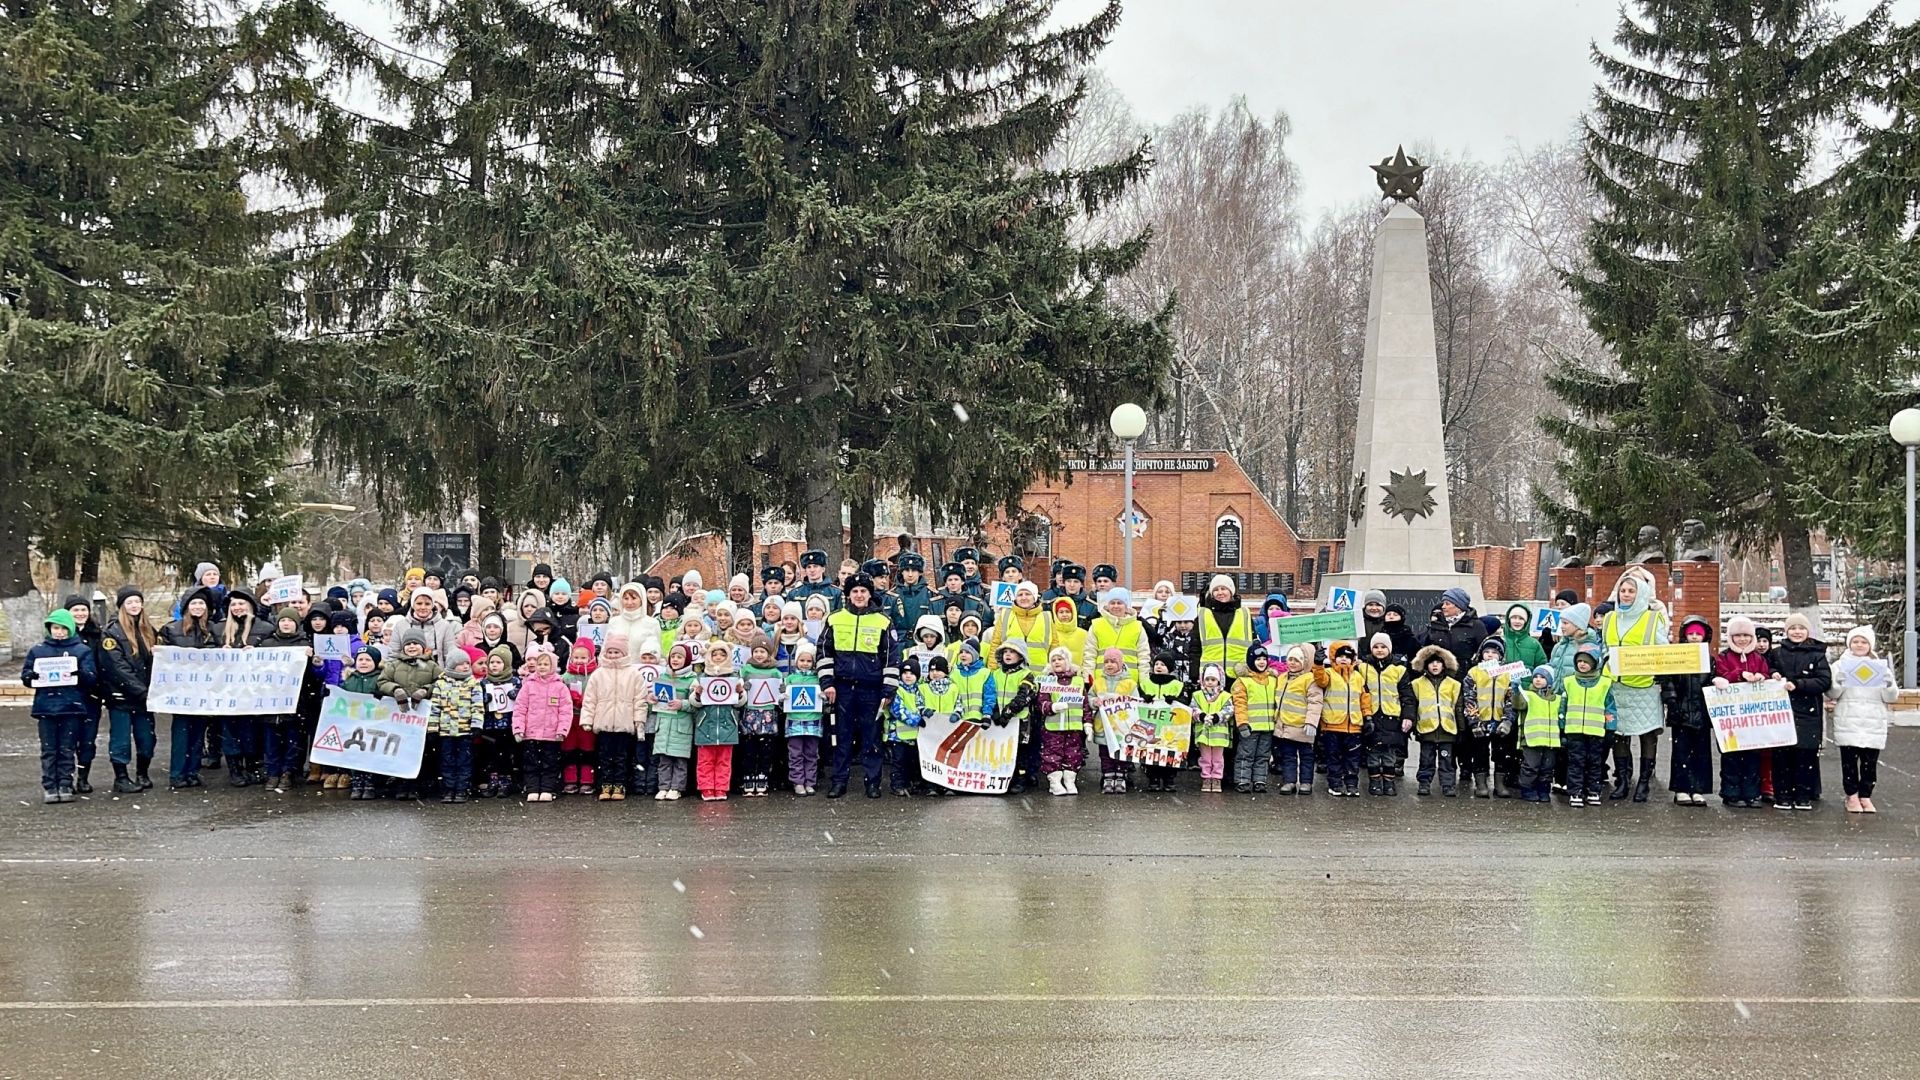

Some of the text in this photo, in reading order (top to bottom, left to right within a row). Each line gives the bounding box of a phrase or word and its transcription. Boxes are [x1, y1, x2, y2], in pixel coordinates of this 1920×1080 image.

[1134, 459, 1163, 470] НИЧТО
[1164, 459, 1175, 470] НЕ
[1176, 459, 1209, 470] ЗАБЫТО
[173, 651, 292, 662] ВСЕМИРНЫЙ
[692, 645, 699, 655] 0
[158, 673, 300, 687] ДЕНЬ ПАМЯТИ
[712, 685, 727, 696] 40
[1040, 685, 1081, 693] БЕЗОПАСНЫЕ
[165, 696, 293, 709] ЖЕРТВ ДТП
[328, 697, 427, 727] ДЕТИ ПРОТИВ
[1147, 709, 1176, 722] НЕТ
[1709, 705, 1737, 718] БУДЬТЕ
[1719, 712, 1791, 730] ВОДИТЕЛИ!!!
[343, 727, 402, 757] ДТП
[922, 760, 943, 775] ДЕНЬ
[947, 769, 987, 779] ПАМЯТИ
[947, 777, 986, 790] ЖЕРТВ
